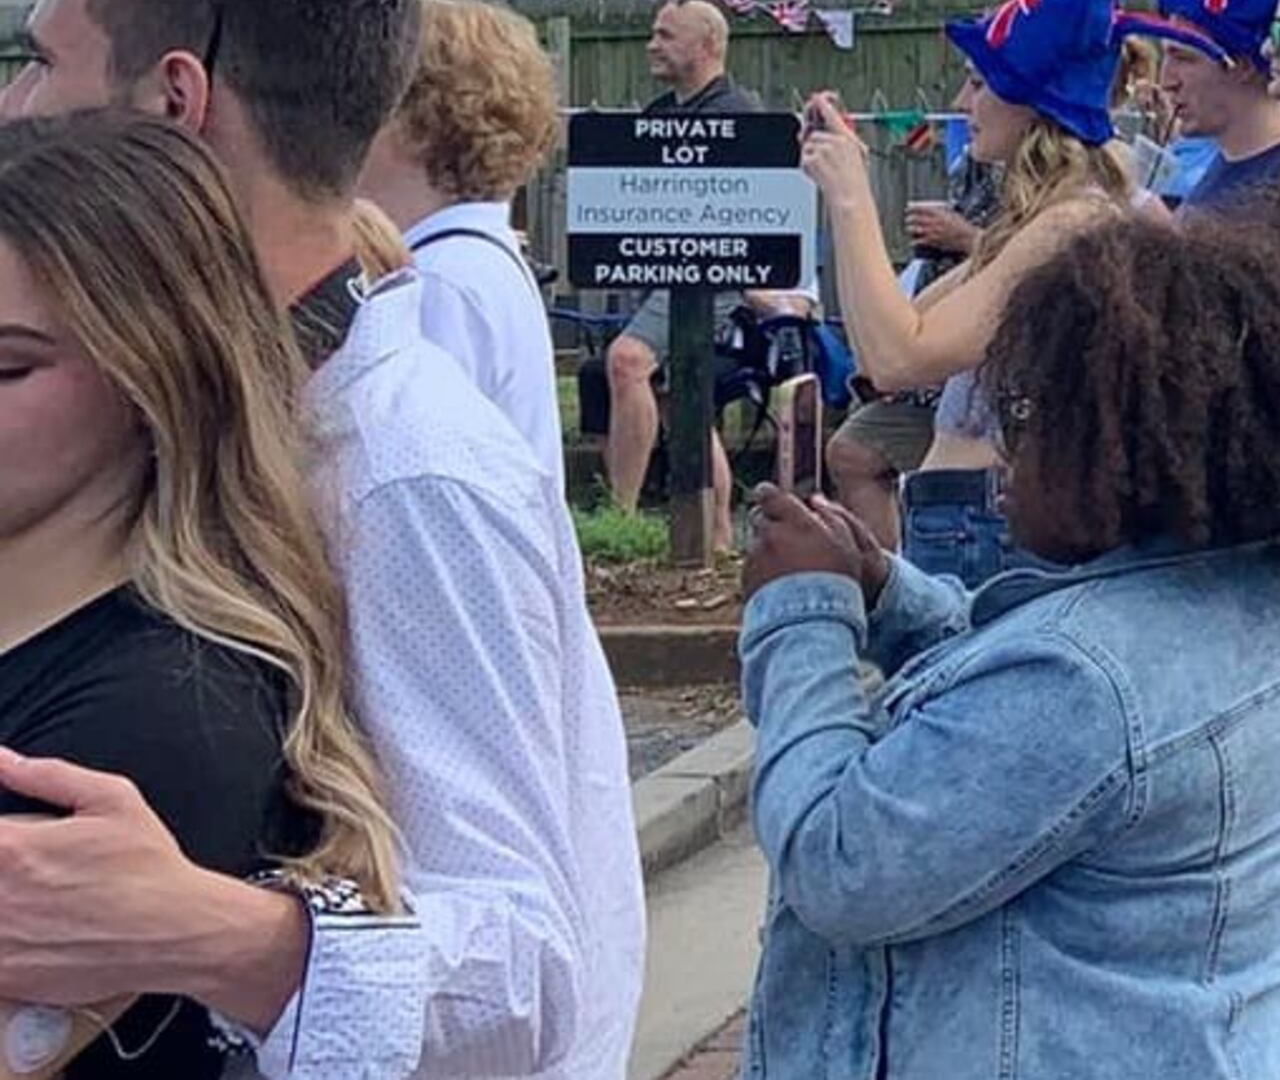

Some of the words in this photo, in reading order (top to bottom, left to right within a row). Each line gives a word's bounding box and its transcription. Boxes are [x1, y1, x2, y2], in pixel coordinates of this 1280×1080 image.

[635, 119, 736, 138] PRIVATE
[662, 146, 709, 163] LOT
[620, 175, 749, 197] Harrington
[577, 205, 693, 223] Insurance
[699, 205, 790, 225] Agency
[619, 238, 748, 257] CUSTOMER
[595, 265, 701, 283] PARKING
[707, 265, 772, 283] ONLY
